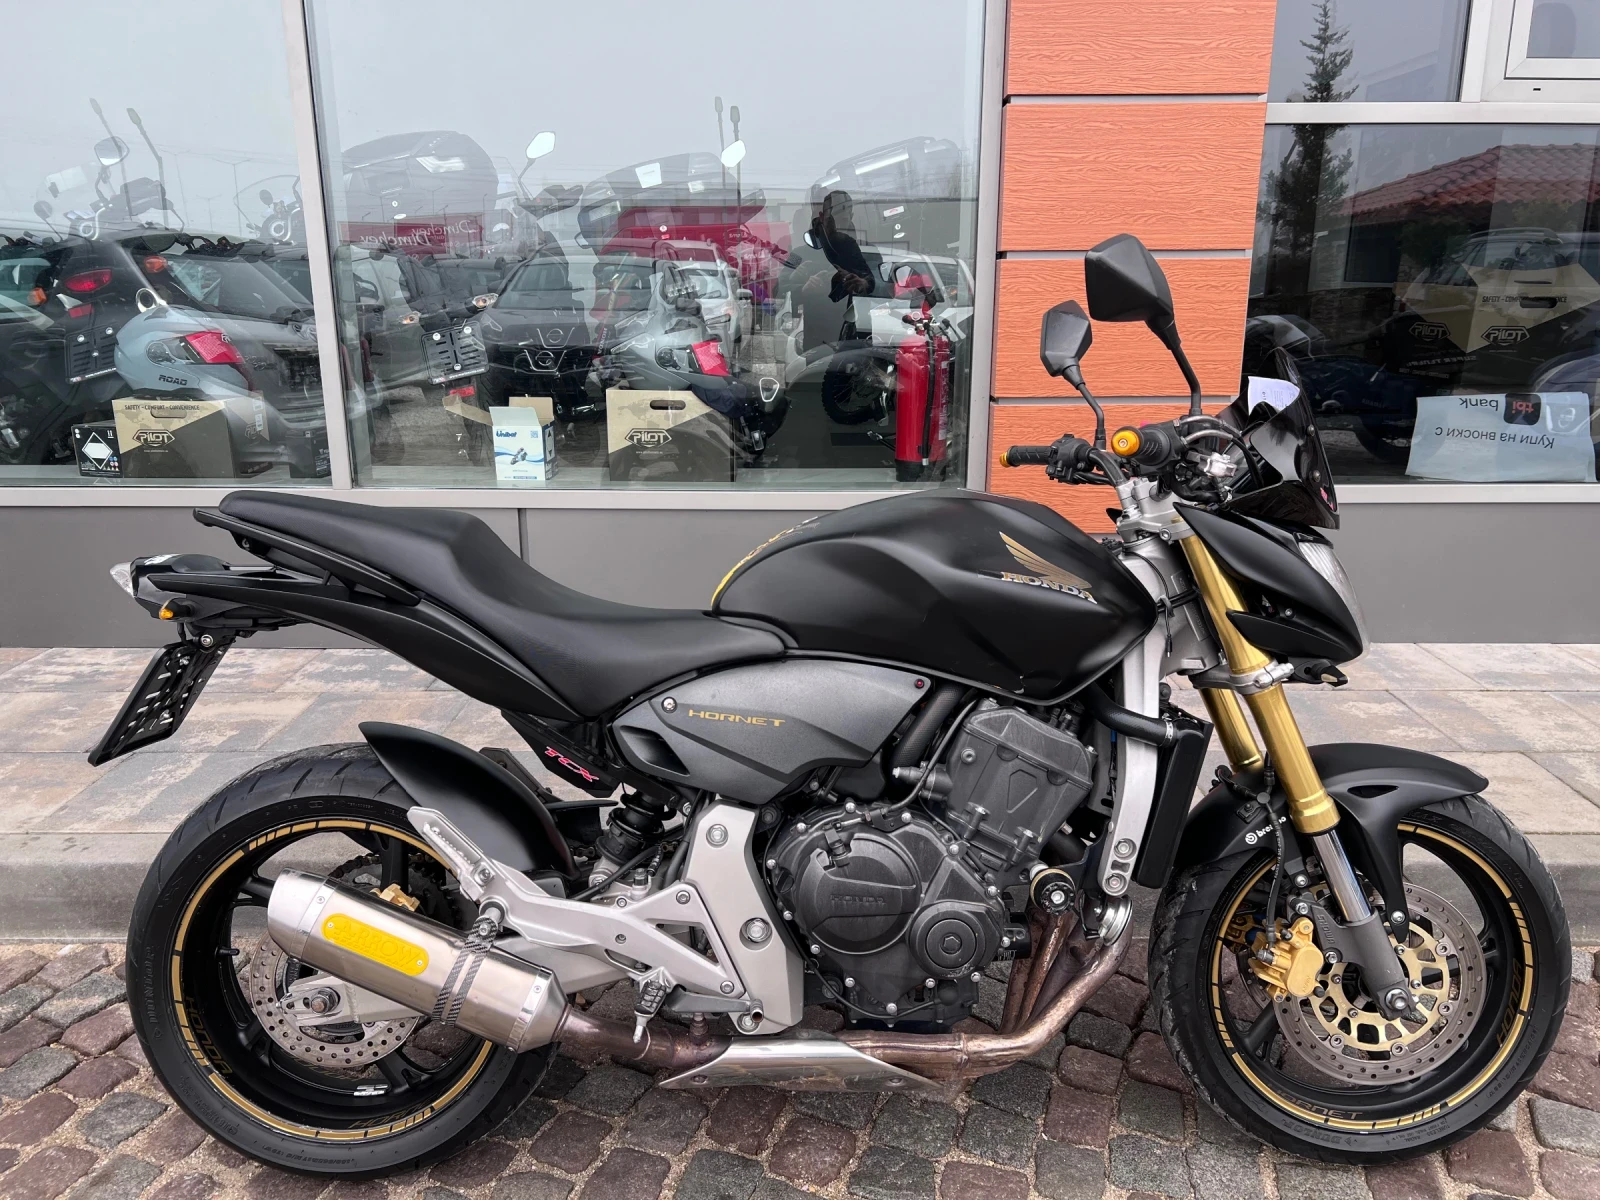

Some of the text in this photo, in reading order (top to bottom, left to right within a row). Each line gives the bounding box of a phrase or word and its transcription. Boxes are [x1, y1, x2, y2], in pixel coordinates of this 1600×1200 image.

[158, 374, 188, 386] ROAD
[1458, 397, 1535, 414] tbi bank
[1446, 427, 1496, 441] вноски
[1499, 432, 1517, 443] на
[1520, 434, 1555, 449] Купи
[1001, 571, 1098, 605] HONDA
[688, 709, 786, 727] HORNET
[1316, 914, 1336, 945] SHOWA
[332, 919, 421, 967] ARROW
[1495, 957, 1522, 1047] HONDA
[185, 995, 234, 1076] HONDA
